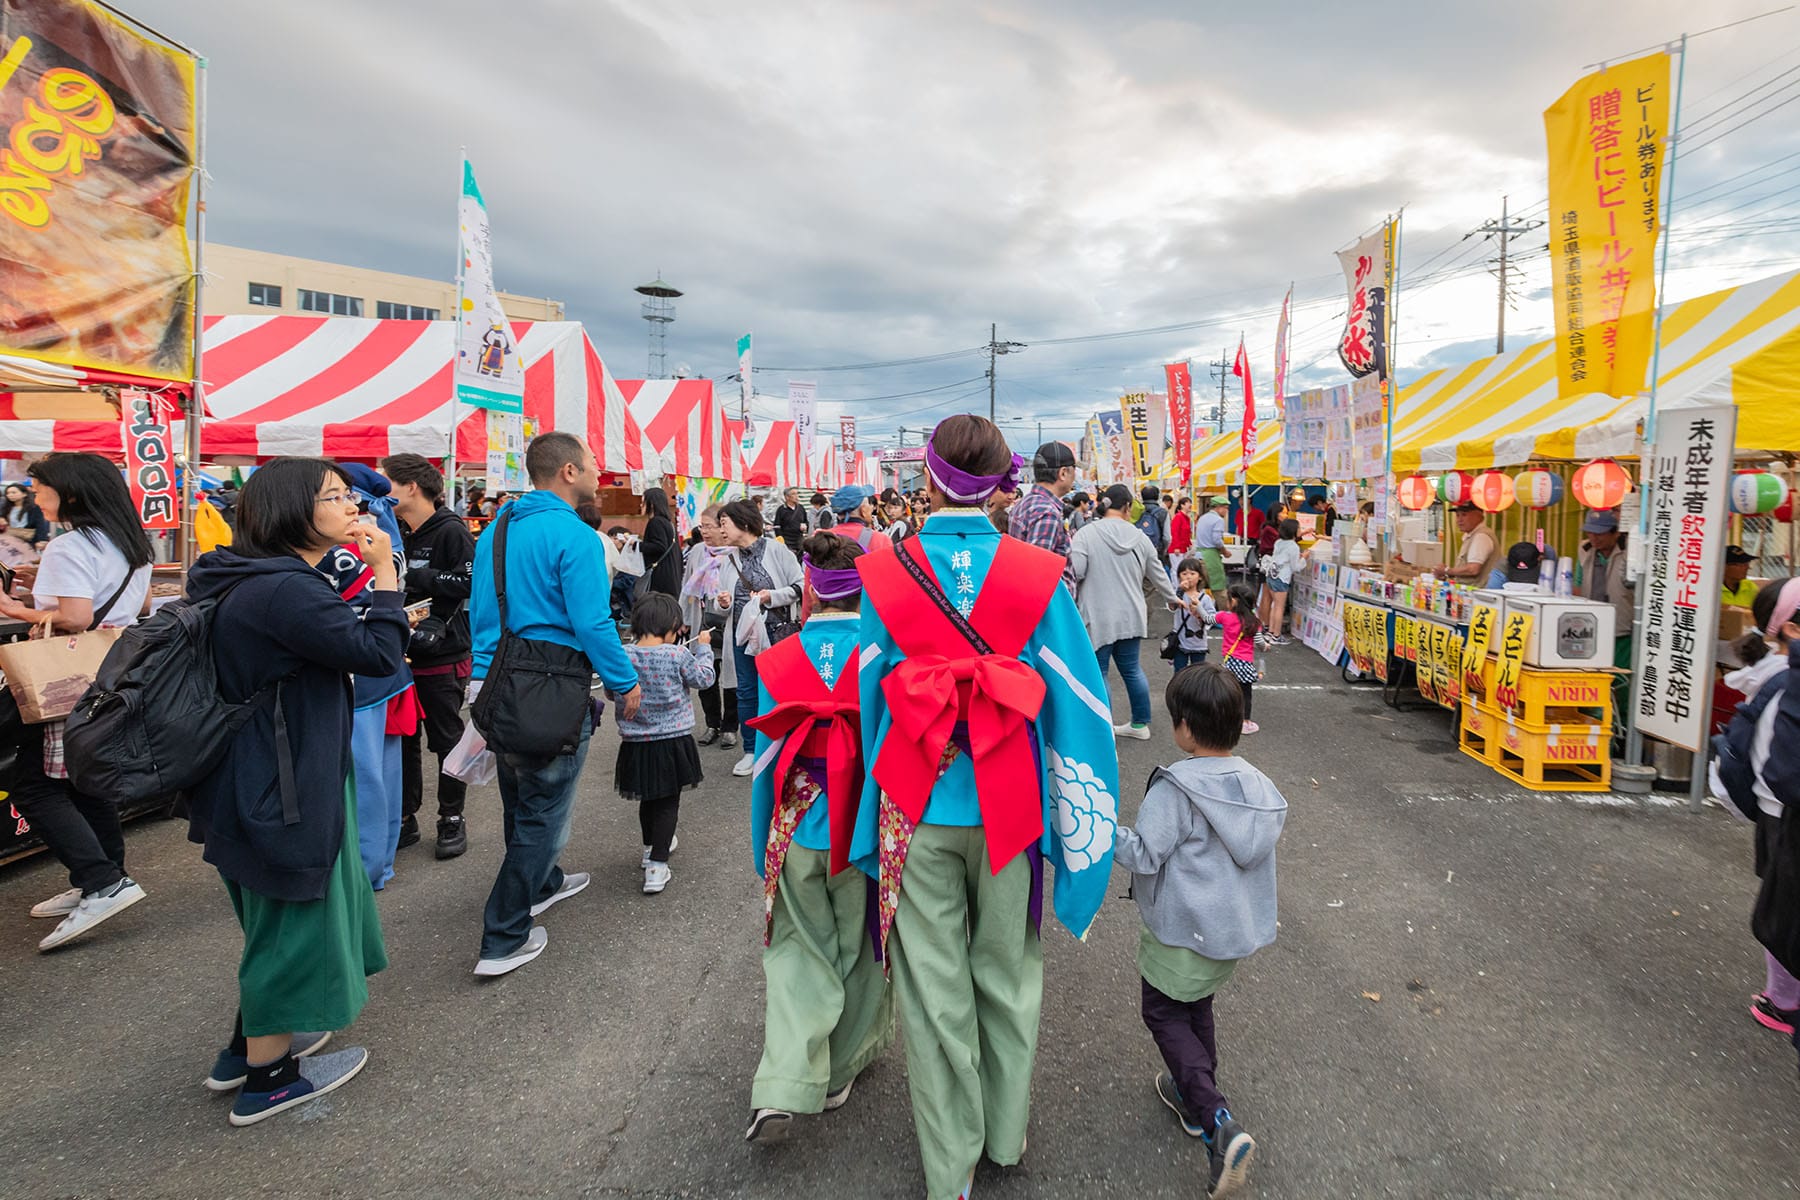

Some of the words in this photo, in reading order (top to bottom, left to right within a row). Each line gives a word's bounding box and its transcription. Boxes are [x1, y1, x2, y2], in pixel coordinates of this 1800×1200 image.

[1635, 82, 1657, 233] ビール券あります
[1343, 255, 1373, 367] かき氷
[130, 399, 173, 523] 100円
[1665, 418, 1715, 723] 未成年者飲酒防止運動実施中
[1464, 607, 1490, 672] 生ビール
[1497, 615, 1524, 687] 生ビール
[1548, 686, 1599, 702] KIRIN
[1546, 745, 1598, 760] KIRIN
